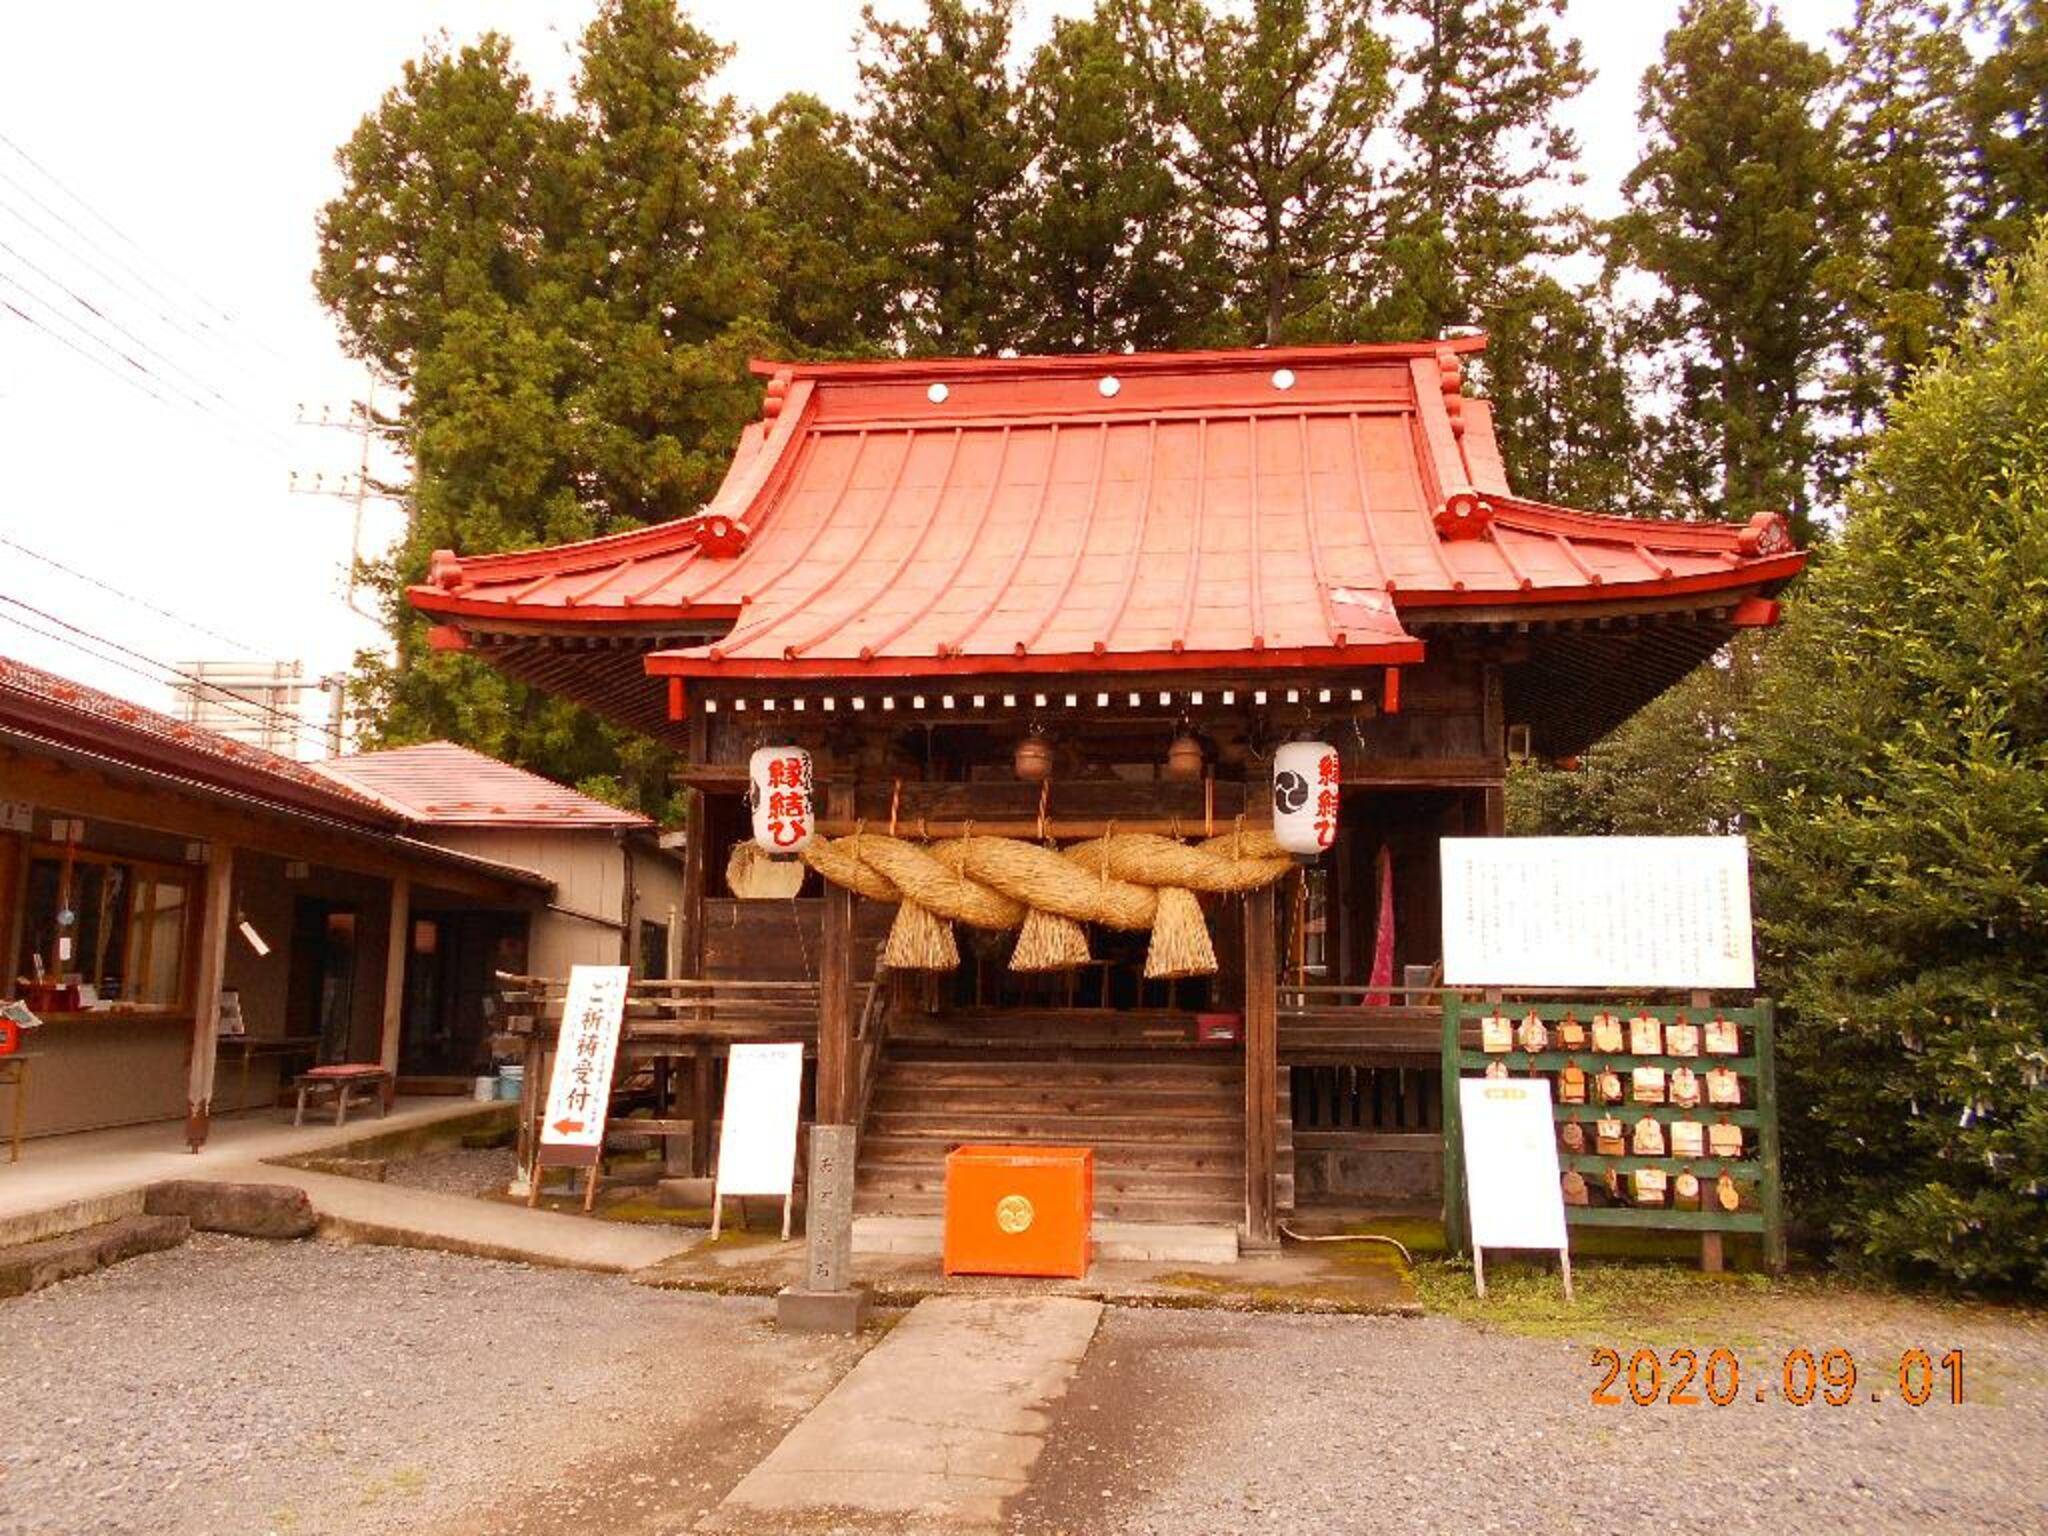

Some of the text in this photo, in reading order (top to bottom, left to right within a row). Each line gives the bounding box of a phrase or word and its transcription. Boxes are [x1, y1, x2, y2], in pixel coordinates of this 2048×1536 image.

[767, 757, 807, 847] 縁結び
[566, 979, 611, 1112] ご祈祷受付
